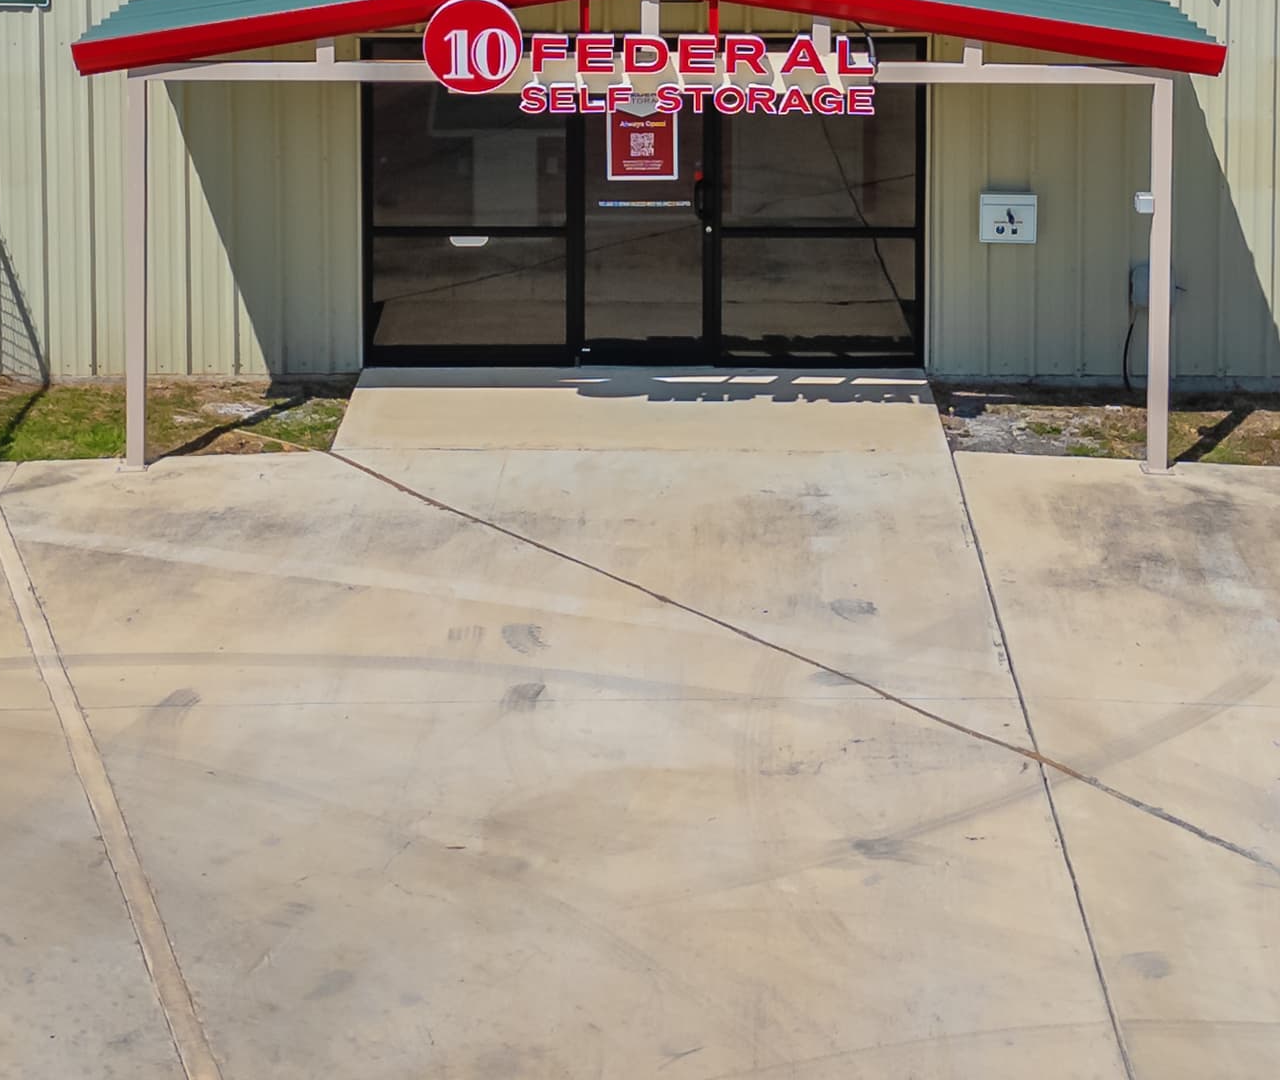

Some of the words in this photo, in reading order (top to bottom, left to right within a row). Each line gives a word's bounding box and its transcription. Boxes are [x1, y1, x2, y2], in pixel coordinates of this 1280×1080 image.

[443, 28, 517, 80] 10
[531, 33, 875, 75] FEDERAL
[520, 83, 633, 113] SELF
[656, 83, 875, 115] STORAGE
